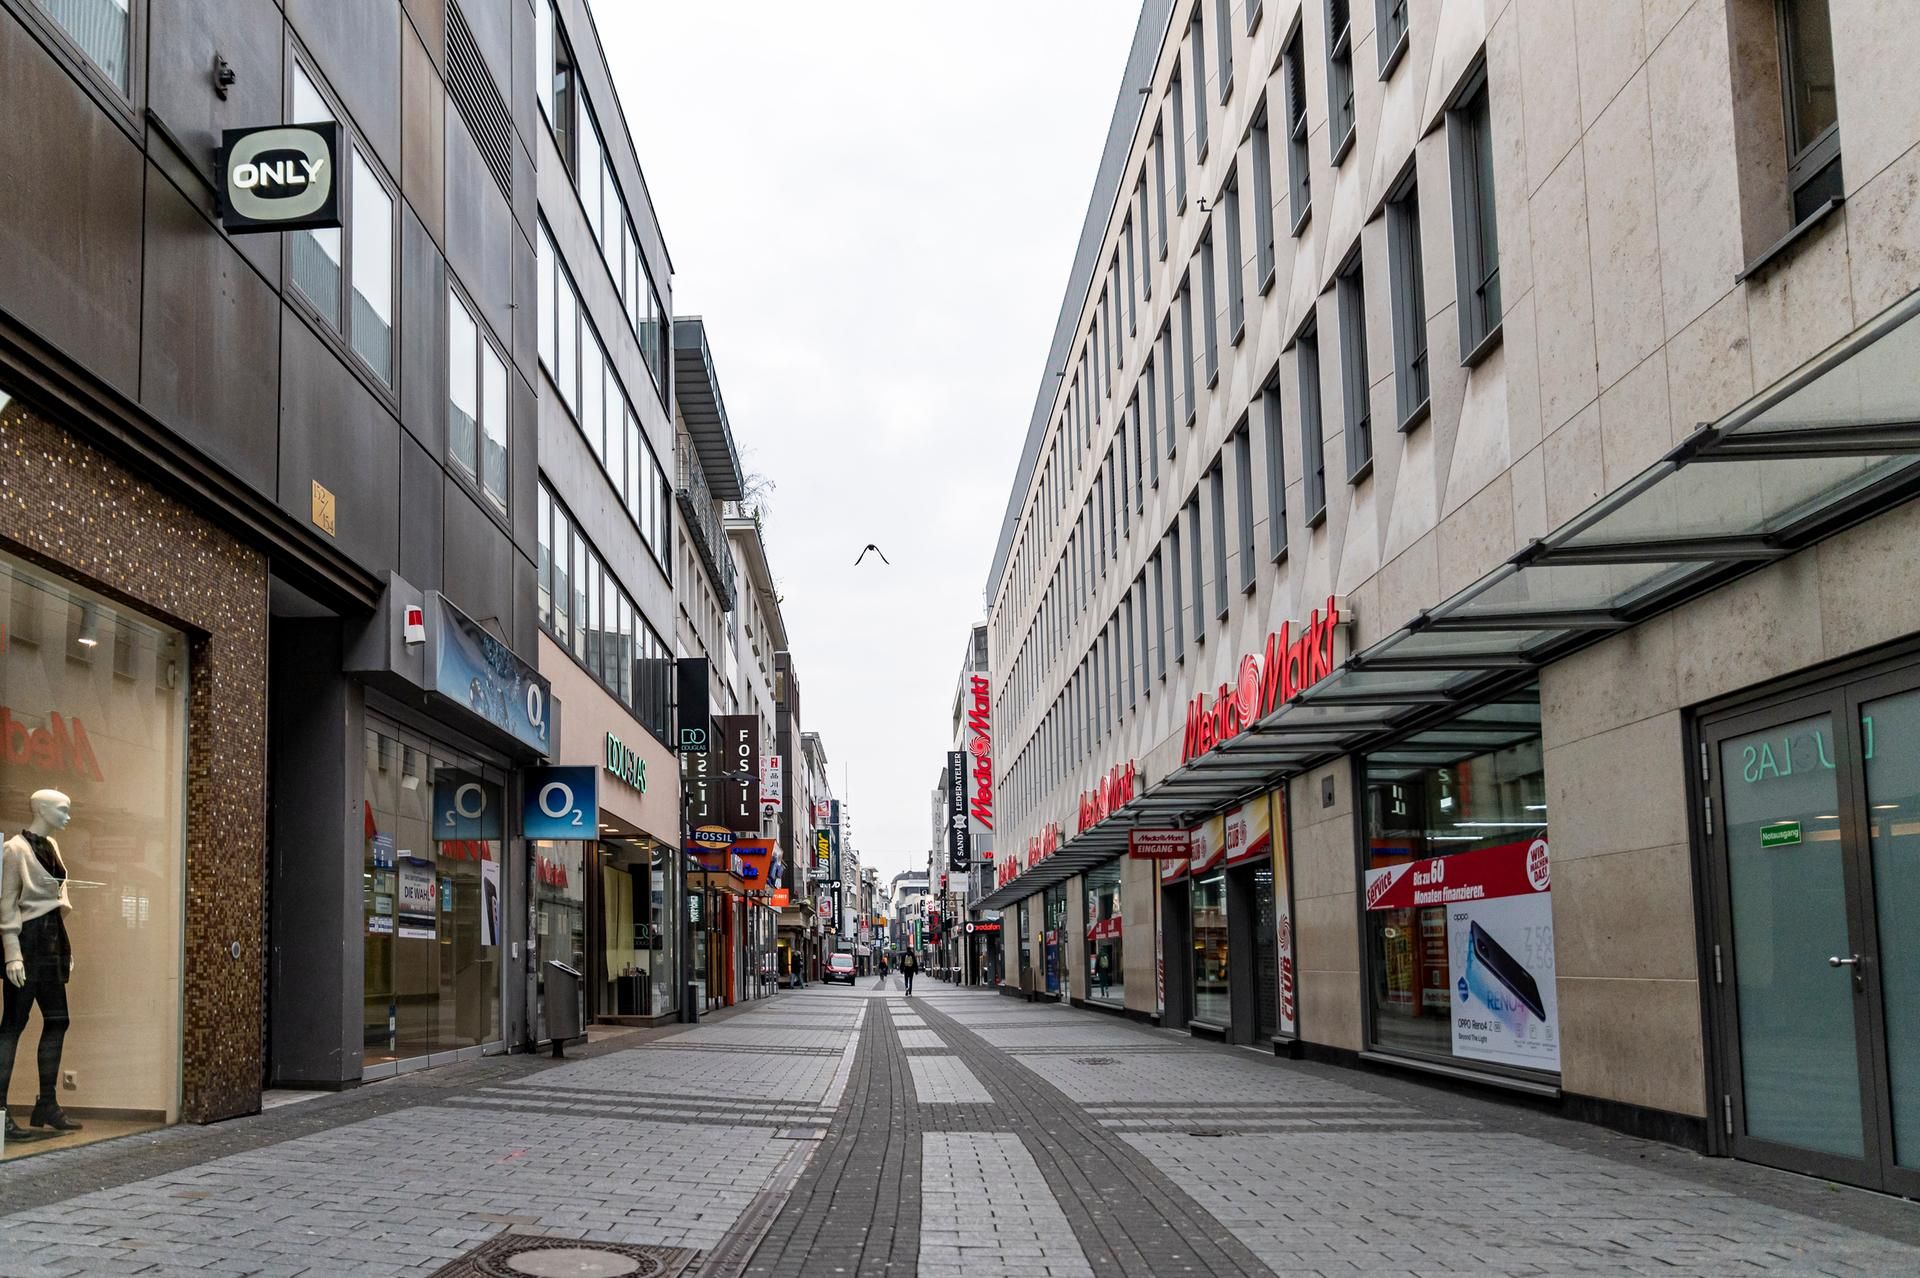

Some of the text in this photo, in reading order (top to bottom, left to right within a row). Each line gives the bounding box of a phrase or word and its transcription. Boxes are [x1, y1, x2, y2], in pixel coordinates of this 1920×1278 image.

[232, 159, 324, 188] ONLY
[1181, 594, 1340, 768] Media Markt
[527, 683, 545, 740] O2
[968, 674, 993, 831] Media Markt
[607, 731, 647, 795] DOUGLAS
[955, 752, 963, 812] LEDERATELIER
[538, 782, 583, 826] O2
[695, 831, 733, 842] FOSSIL
[957, 829, 965, 857] SANDY
[1228, 829, 1239, 849] CLUB
[1762, 828, 1799, 841] Notausgang
[1137, 845, 1173, 853] EINGANG
[1530, 845, 1545, 863] WIR
[1413, 859, 1445, 886] Bis zu 60
[1530, 856, 1548, 873] MACHEN
[1534, 867, 1548, 883] DAS!
[404, 886, 430, 901] DIE WAHL
[1367, 870, 1392, 905] service
[1414, 884, 1485, 905] Monaten finanzieren.
[1453, 913, 1468, 921] oppo
[975, 923, 1001, 932] vodafon
[1283, 955, 1295, 1022] CLUB
[1458, 1018, 1471, 1030] OPPO
[1472, 1019, 1487, 1031] Reno4
[1458, 1033, 1471, 1042] Beyond
[1478, 1035, 1487, 1043] Light
